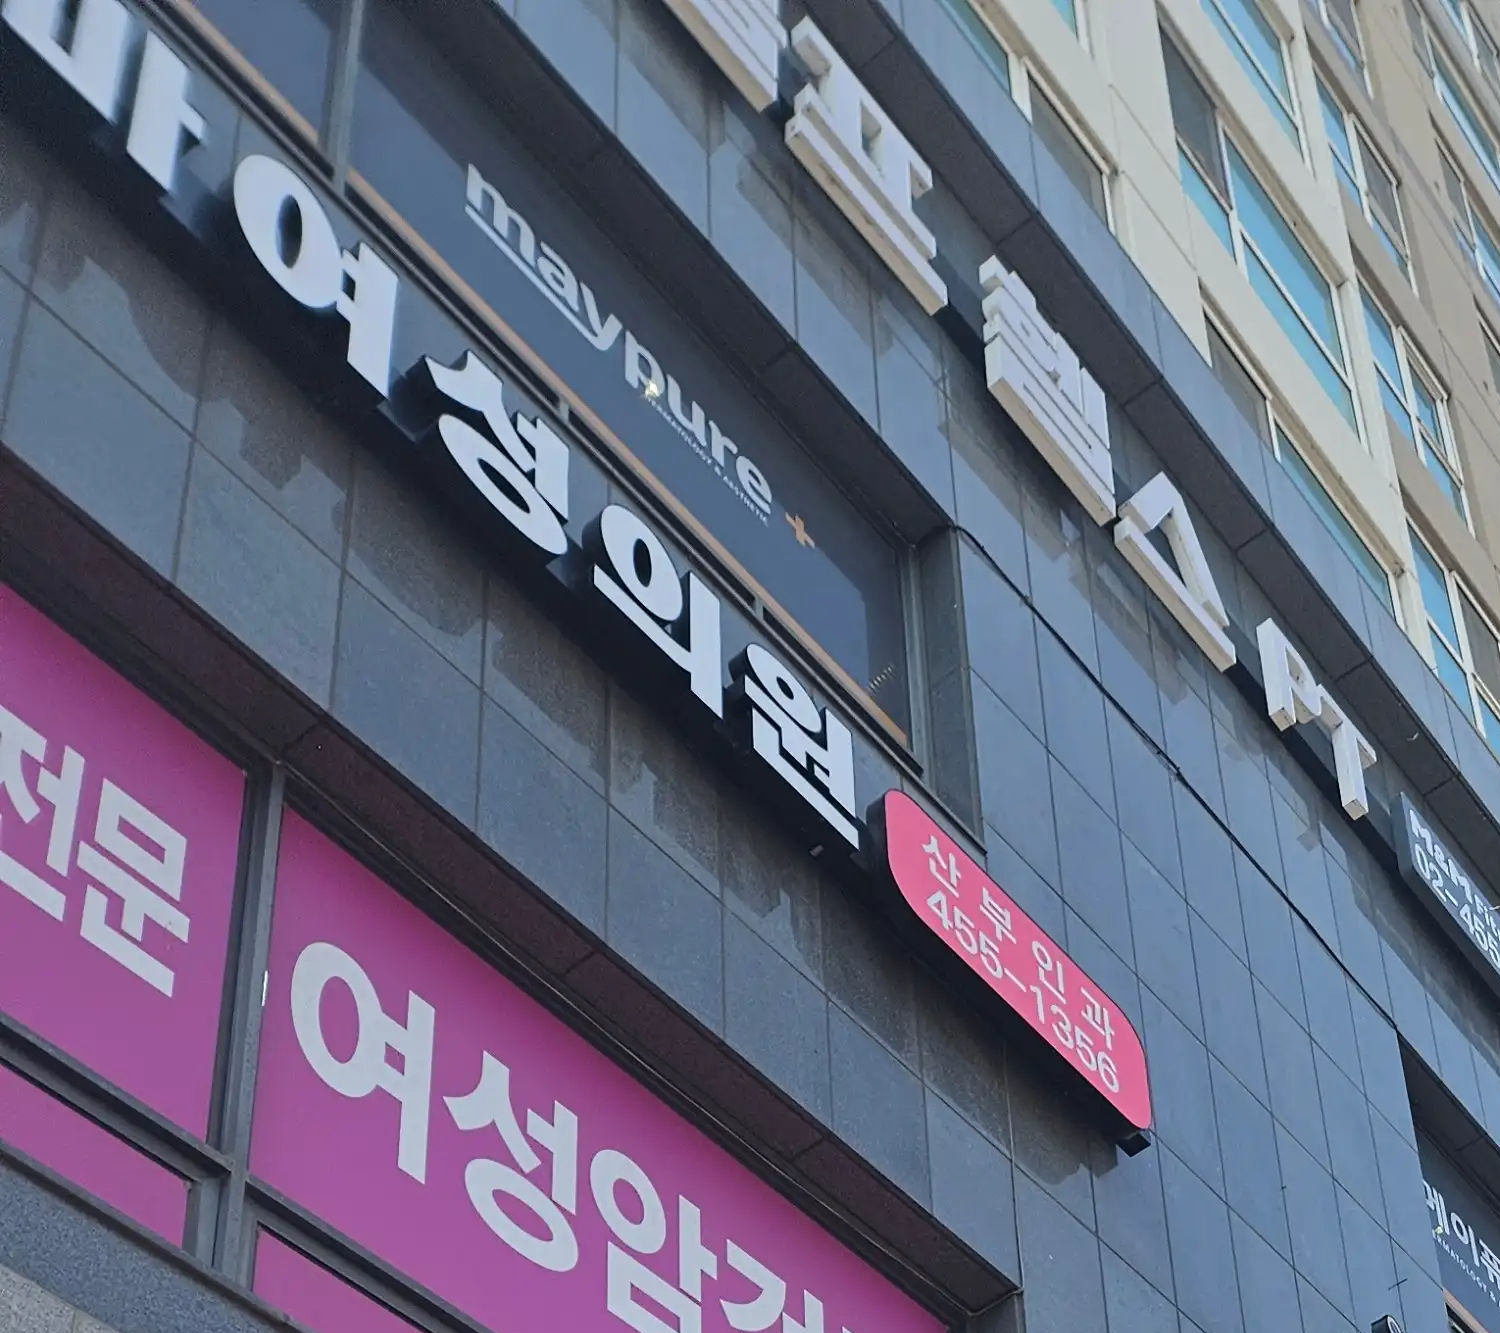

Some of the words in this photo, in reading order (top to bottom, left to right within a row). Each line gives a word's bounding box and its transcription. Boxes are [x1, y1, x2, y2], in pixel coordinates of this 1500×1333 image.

[465, 163, 773, 515] maypure
[979, 255, 1236, 672] 헬스
[1256, 618, 1377, 820] PT
[926, 891, 1120, 1092] 455-1356
[1409, 809, 1474, 904] M&M
